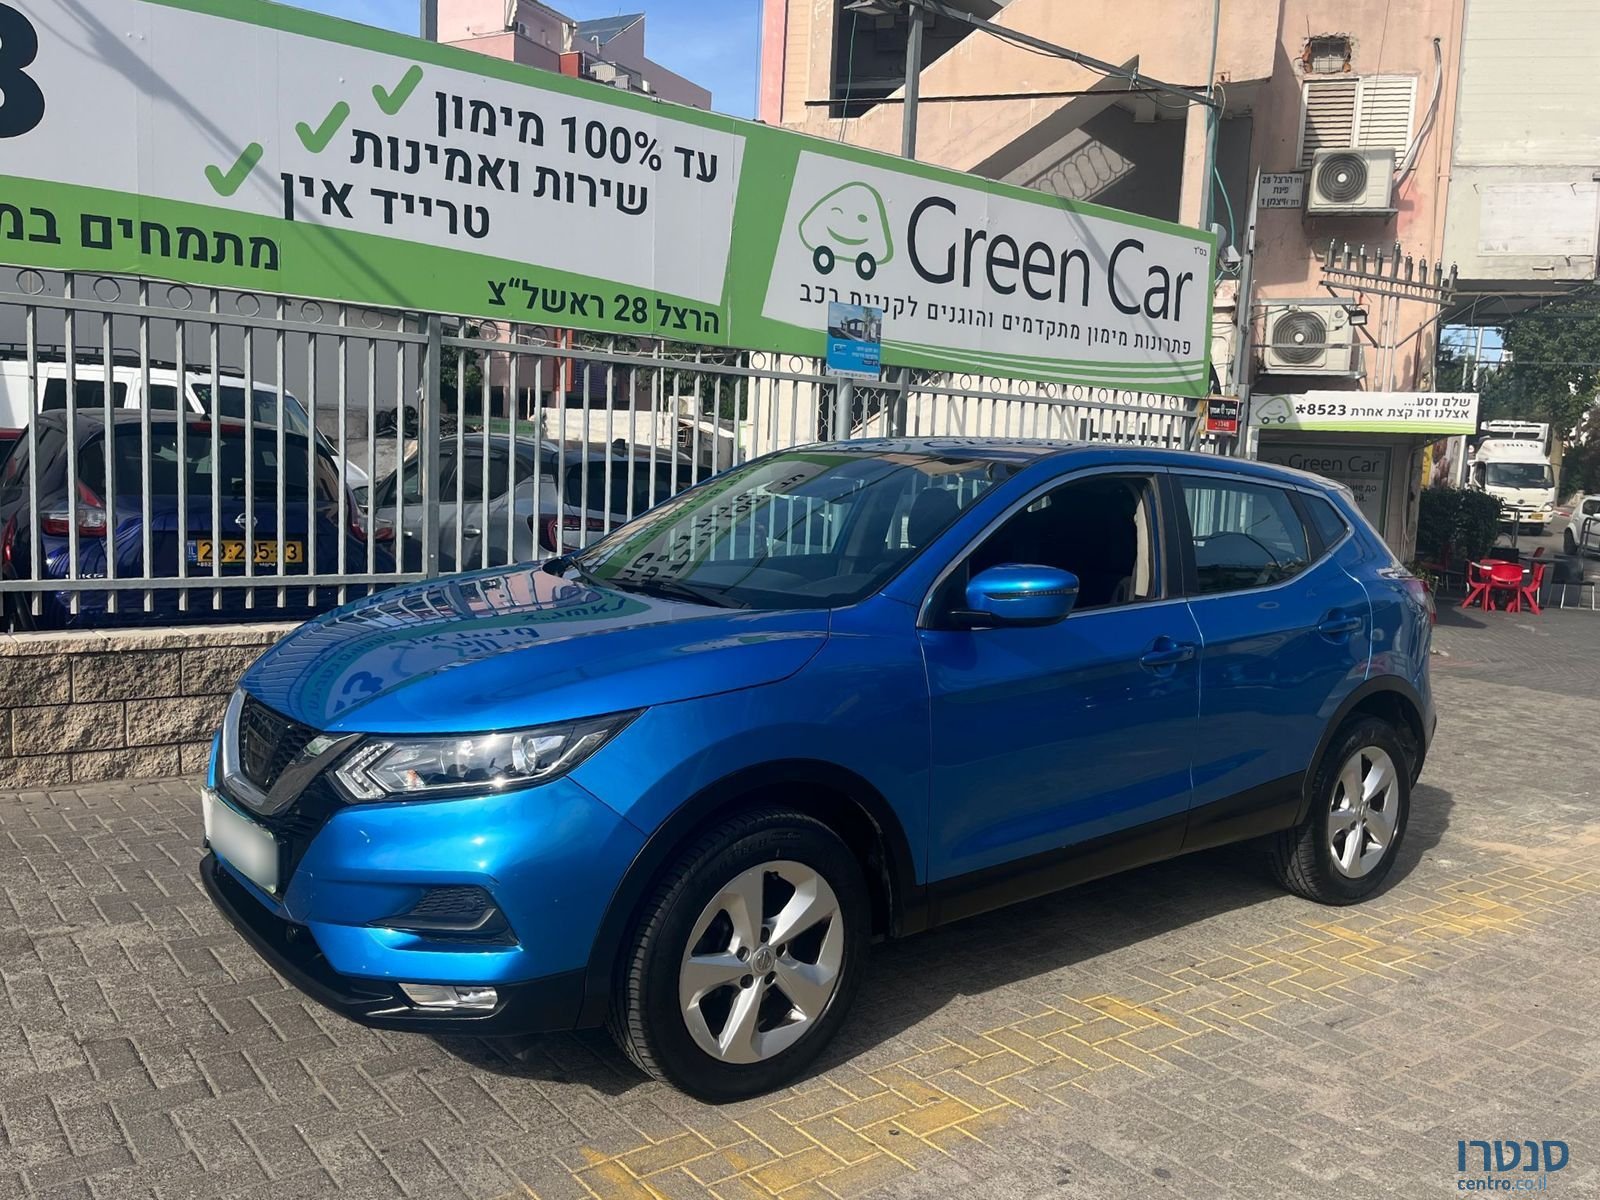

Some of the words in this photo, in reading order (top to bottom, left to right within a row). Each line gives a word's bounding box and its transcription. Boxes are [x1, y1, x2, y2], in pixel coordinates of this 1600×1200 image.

[435, 91, 544, 146] מימון
[561, 117, 662, 171] 100%
[350, 129, 519, 193] ואמינות
[674, 146, 718, 183] עד
[280, 172, 354, 221] אין
[533, 165, 648, 215] שירות
[370, 188, 490, 239] טרייד
[80, 213, 279, 271] מתמחים
[907, 196, 1090, 306] Green
[1107, 238, 1193, 322] Car
[800, 283, 839, 304] רכב
[614, 294, 648, 324] 28
[656, 299, 719, 334] הרצל
[928, 303, 993, 328] והוגנים
[1002, 314, 1080, 341] מתקדמים
[1087, 326, 1128, 346] מימון
[1134, 333, 1191, 355] פתרונות
[1350, 406, 1384, 417] אחרת
[1387, 407, 1413, 419] קצת
[1416, 408, 1430, 417] זה
[1434, 407, 1469, 419] אצלנו
[1442, 396, 1471, 407] שלם
[1288, 454, 1343, 471] Green
[1348, 456, 1380, 473] Car
